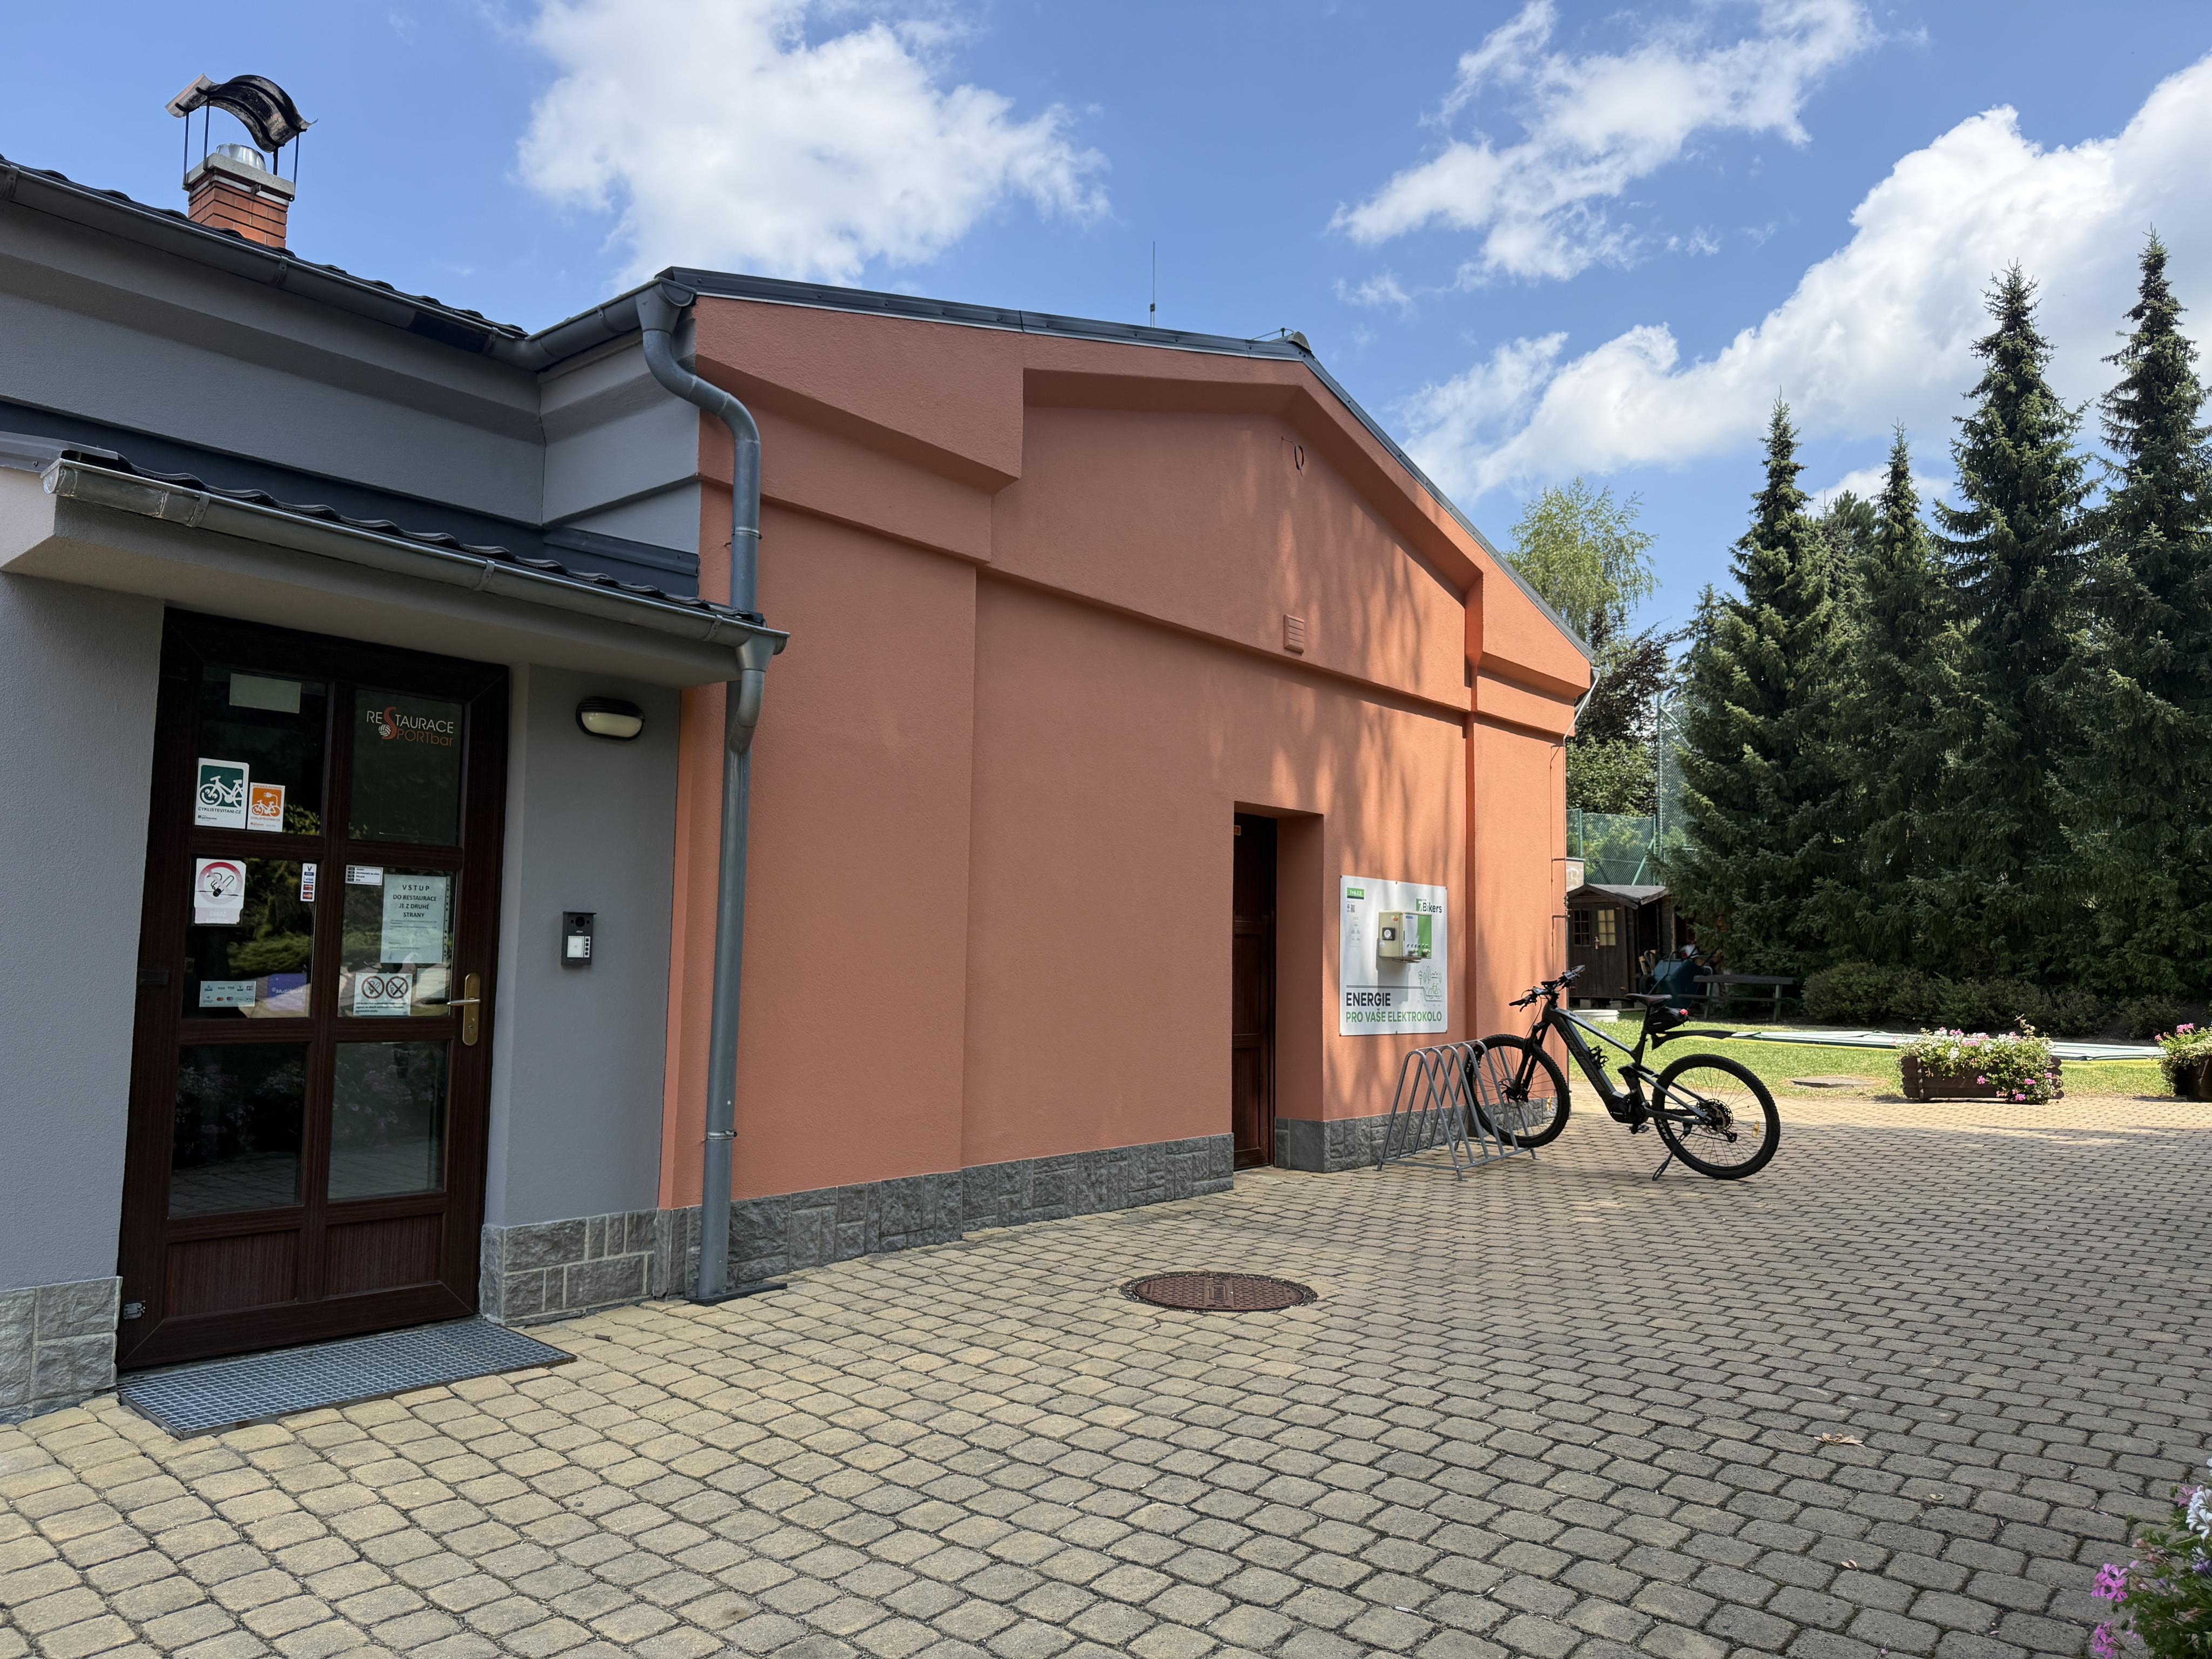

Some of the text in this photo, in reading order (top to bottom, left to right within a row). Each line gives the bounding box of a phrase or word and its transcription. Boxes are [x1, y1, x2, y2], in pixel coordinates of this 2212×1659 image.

[1346, 992, 1391, 1007] ENERGIE
[1346, 1008, 1442, 1023] PRO VAŠE ELEKTROKOLO
